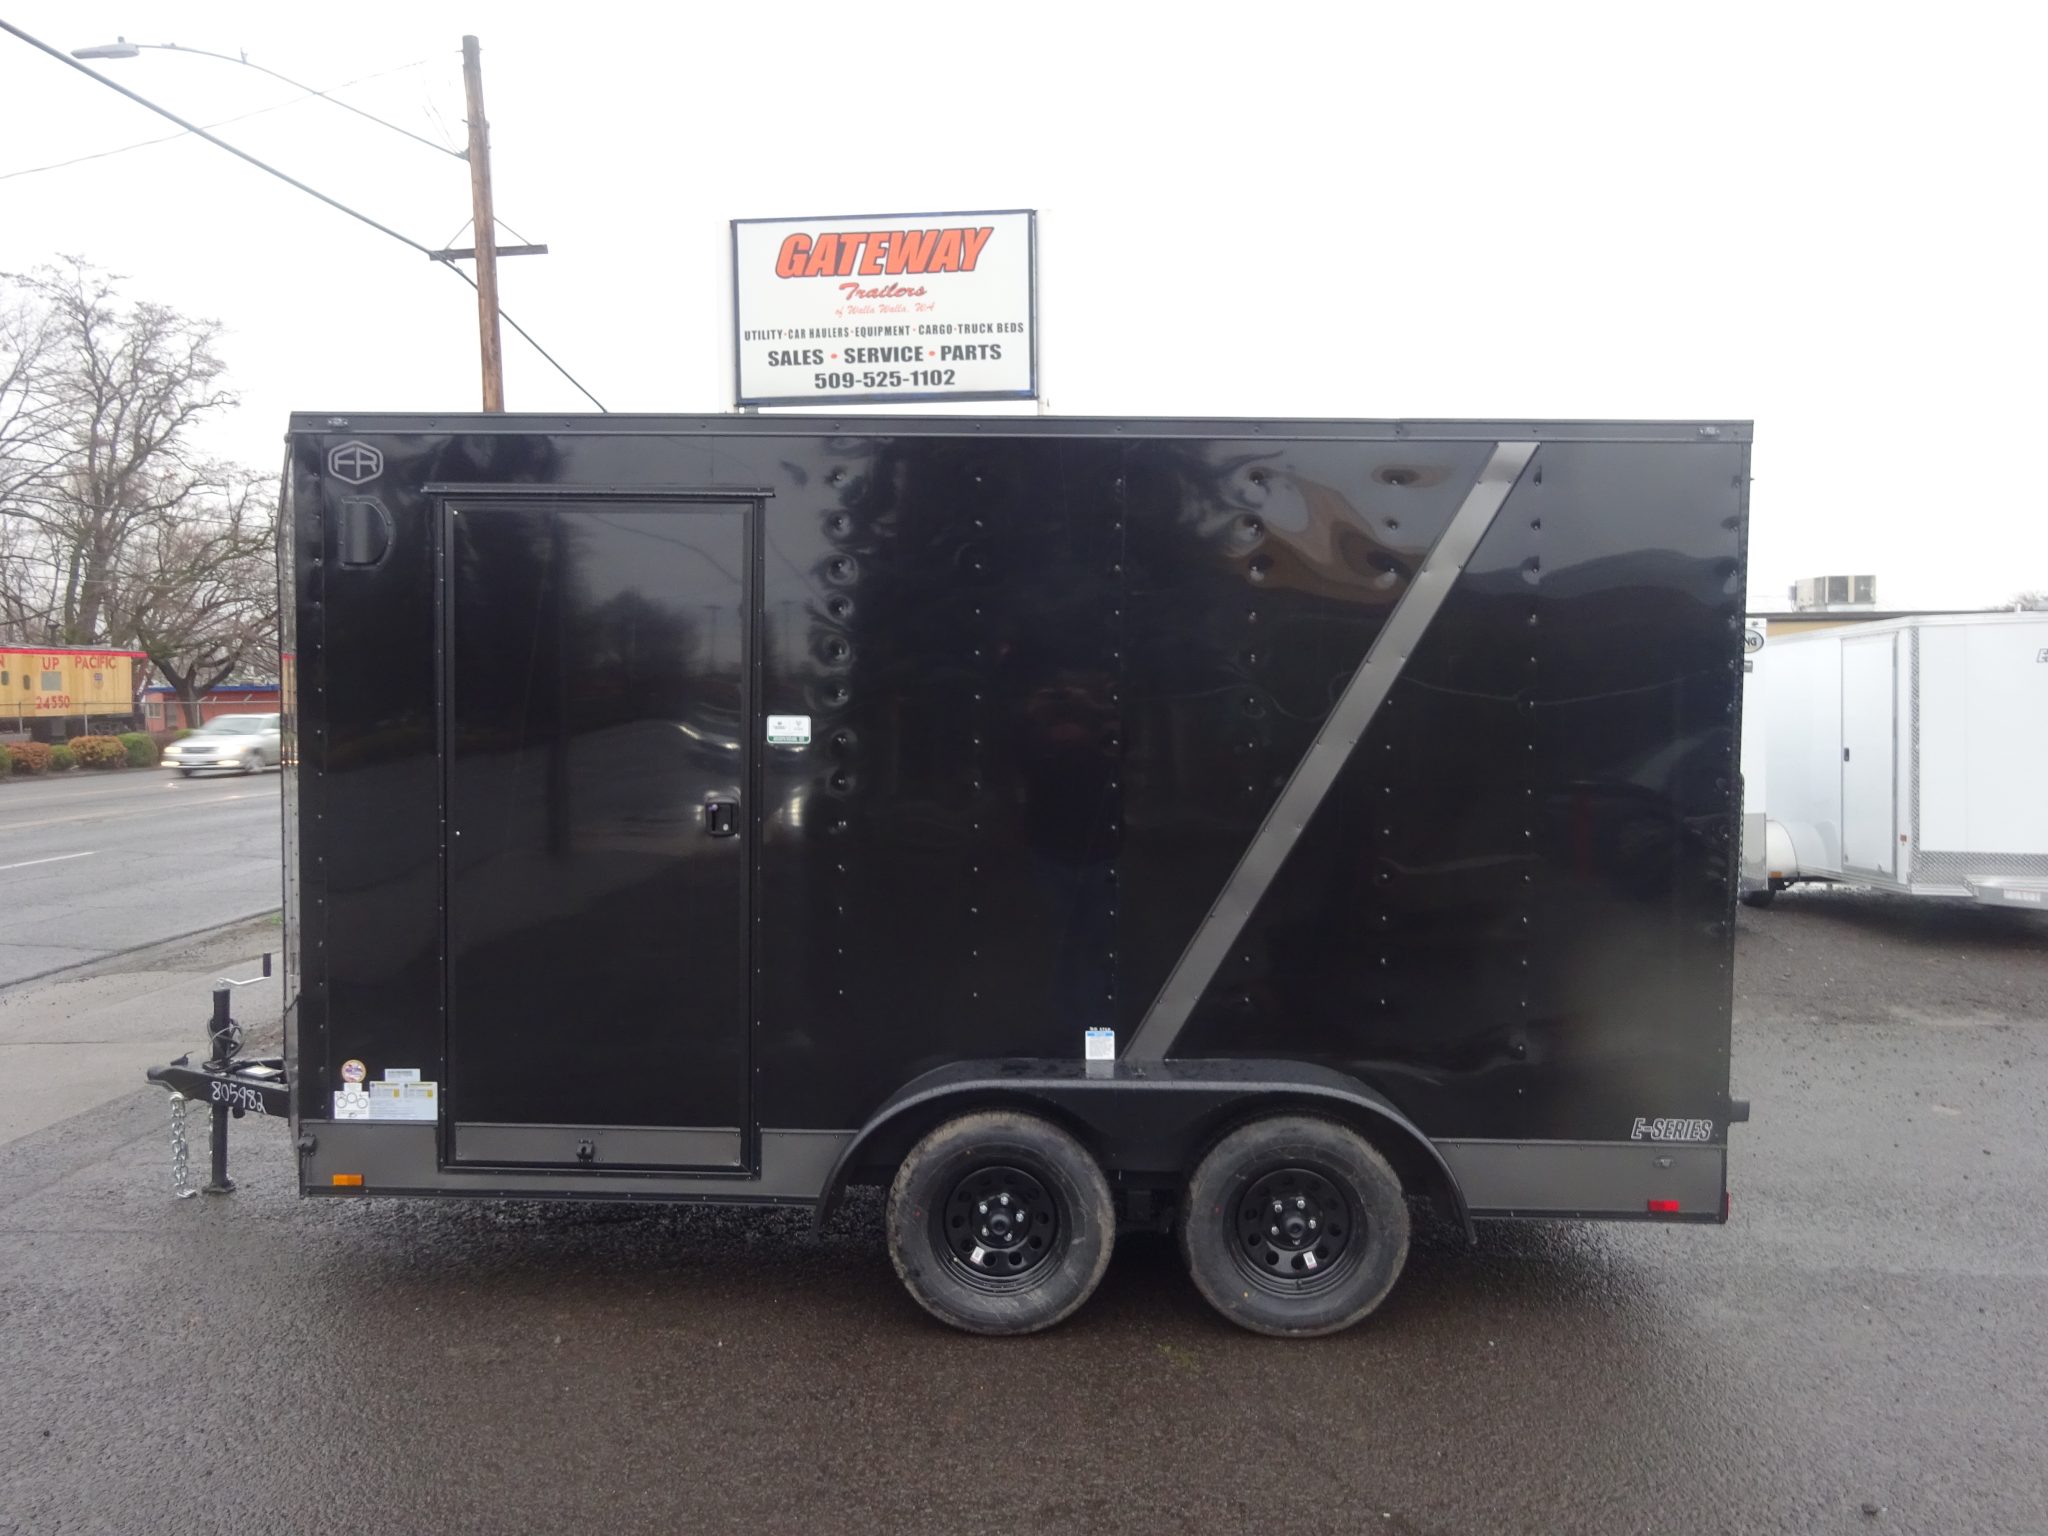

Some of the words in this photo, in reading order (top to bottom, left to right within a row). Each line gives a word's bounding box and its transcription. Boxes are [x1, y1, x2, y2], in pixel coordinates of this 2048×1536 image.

[775, 226, 994, 279] GATEWAY
[838, 282, 927, 301] Trailers
[847, 305, 876, 315] Walla
[744, 329, 784, 341] UTILITY
[788, 328, 807, 340] CAR
[809, 326, 850, 339] HAULERS
[854, 325, 911, 337] EQUIPMENT
[918, 323, 953, 336] CARGO
[958, 322, 994, 334] TRUCK
[996, 322, 1024, 334] BEDS
[767, 348, 825, 367] SALES
[843, 345, 925, 364] SERVICE
[940, 343, 1003, 362] PARTS
[814, 369, 956, 390] 509-525-1102
[42, 656, 60, 670] UP
[74, 655, 117, 670] PACIFIC
[36, 695, 71, 709] 24550
[211, 1080, 267, 1114] 805982
[1630, 1117, 1713, 1141] E-SERIES
